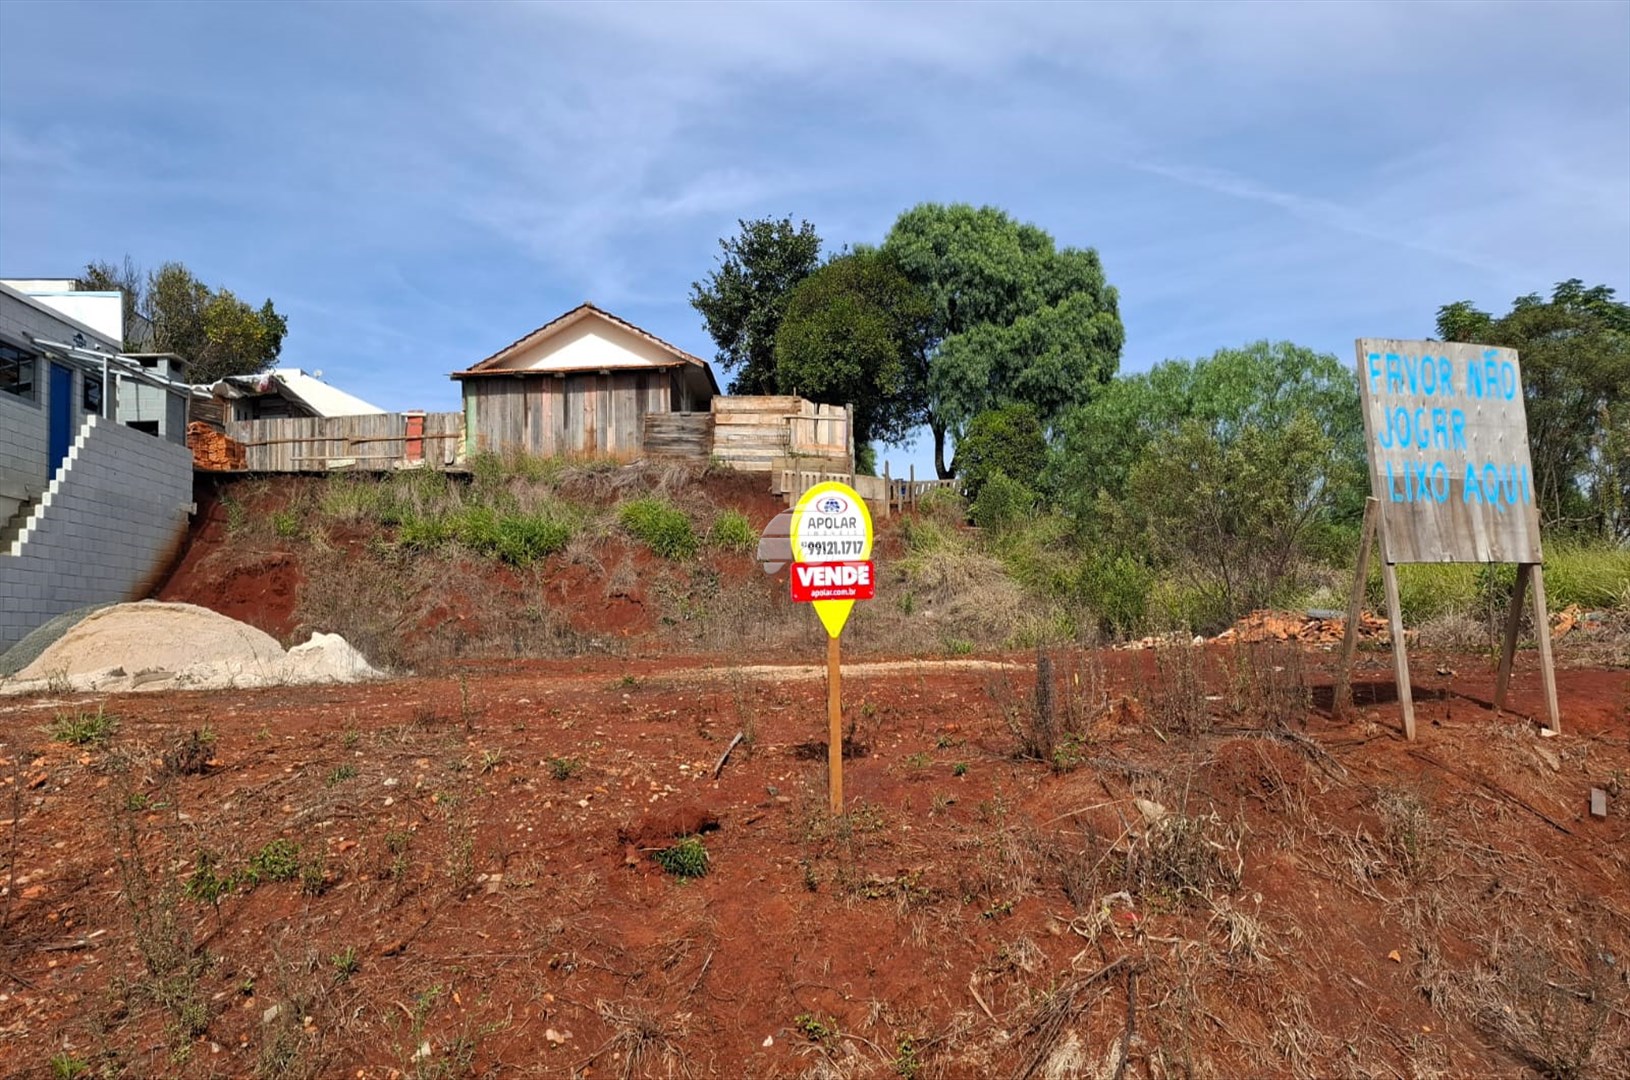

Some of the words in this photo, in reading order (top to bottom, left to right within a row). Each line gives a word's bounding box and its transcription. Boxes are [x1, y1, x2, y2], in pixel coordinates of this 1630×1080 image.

[1367, 352, 1455, 397] FAVOR
[1466, 349, 1517, 401] NÃO
[1378, 406, 1467, 450] JOGAR
[1385, 460, 1450, 504] LIXO
[1462, 462, 1531, 513] AQUI
[808, 517, 856, 529] APOLAR
[807, 541, 863, 555] 99121.1717
[796, 565, 870, 587] VENDE
[811, 588, 856, 598] apolar.com.br
